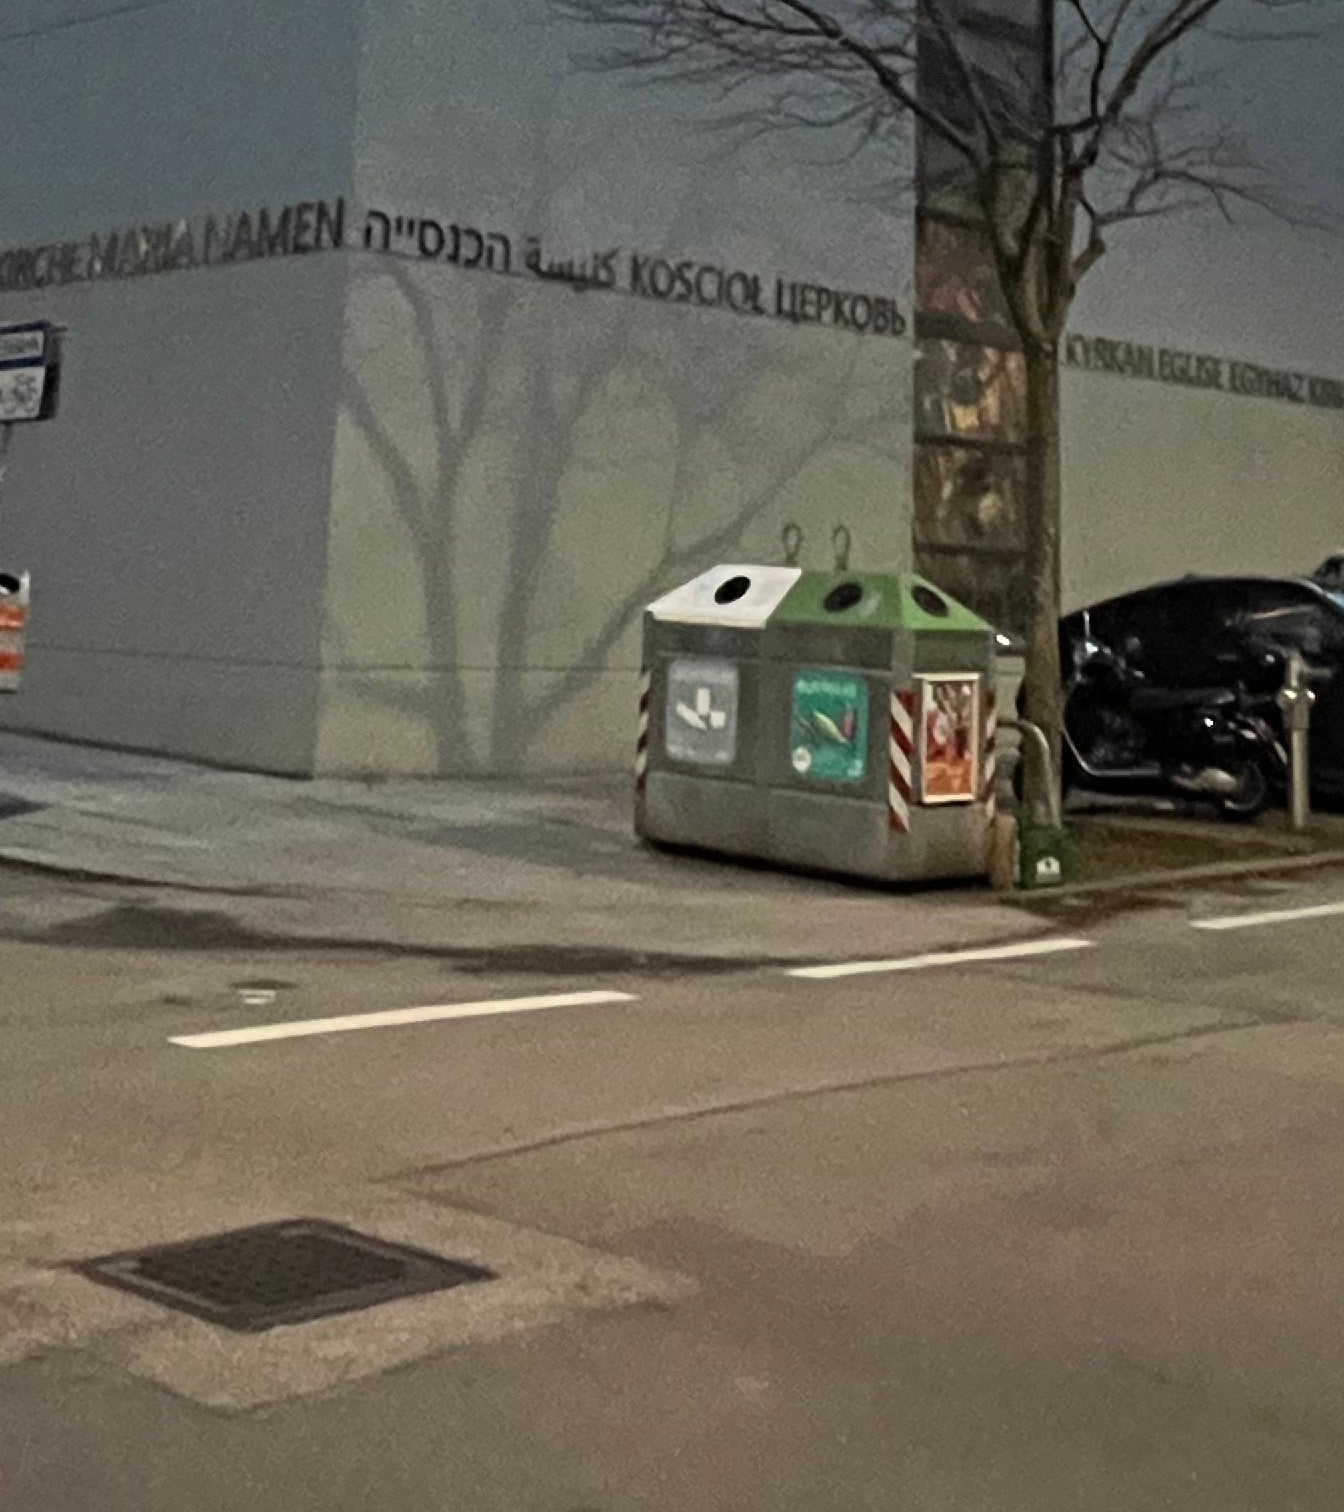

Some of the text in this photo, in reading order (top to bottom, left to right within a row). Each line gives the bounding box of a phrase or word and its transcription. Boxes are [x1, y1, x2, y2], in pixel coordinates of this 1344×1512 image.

[203, 196, 344, 267] NAMEN
[364, 210, 511, 273] הכנסייה
[775, 277, 907, 336] ЦЕРКОВЬ
